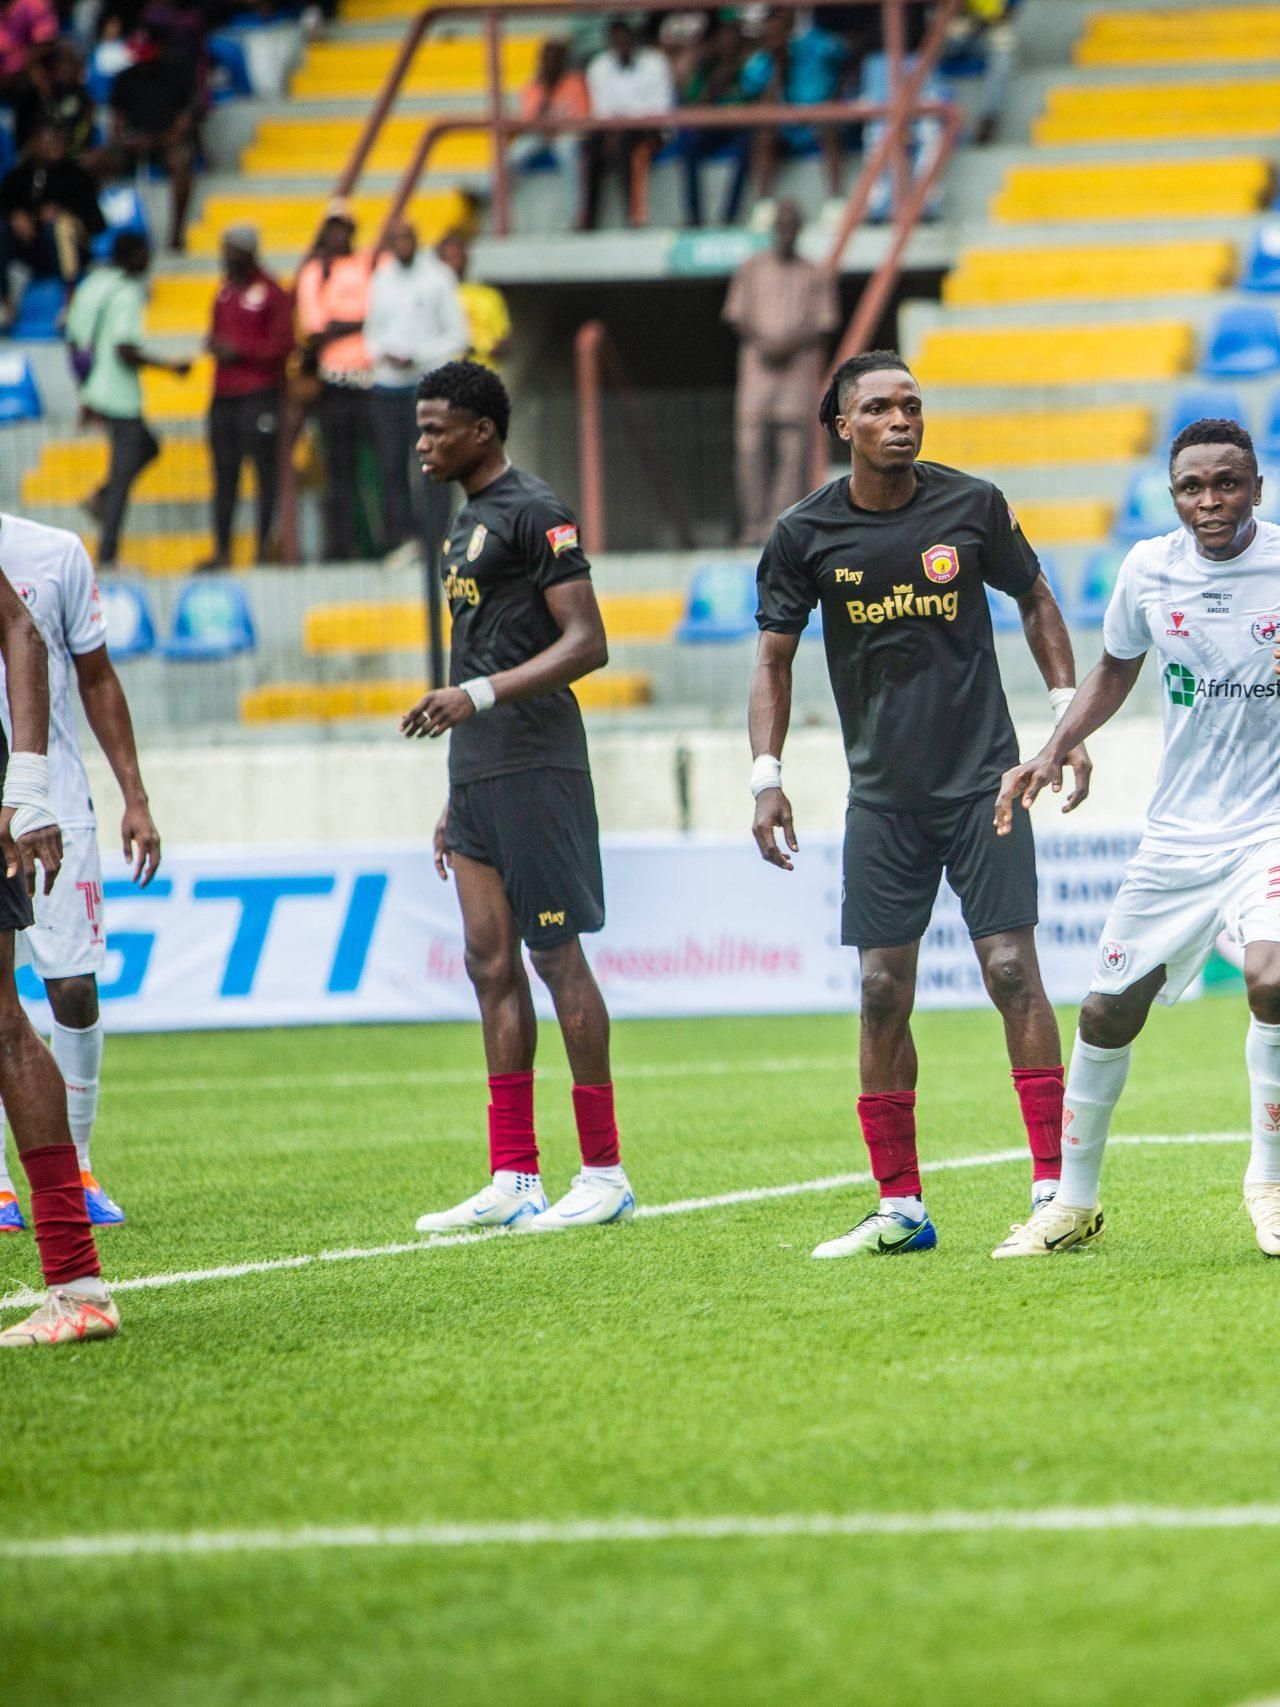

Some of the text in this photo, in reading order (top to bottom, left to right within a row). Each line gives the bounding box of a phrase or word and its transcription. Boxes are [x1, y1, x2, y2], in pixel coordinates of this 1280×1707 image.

[834, 568, 864, 585] Play
[846, 590, 959, 624] BetKing
[538, 909, 566, 928] Play
